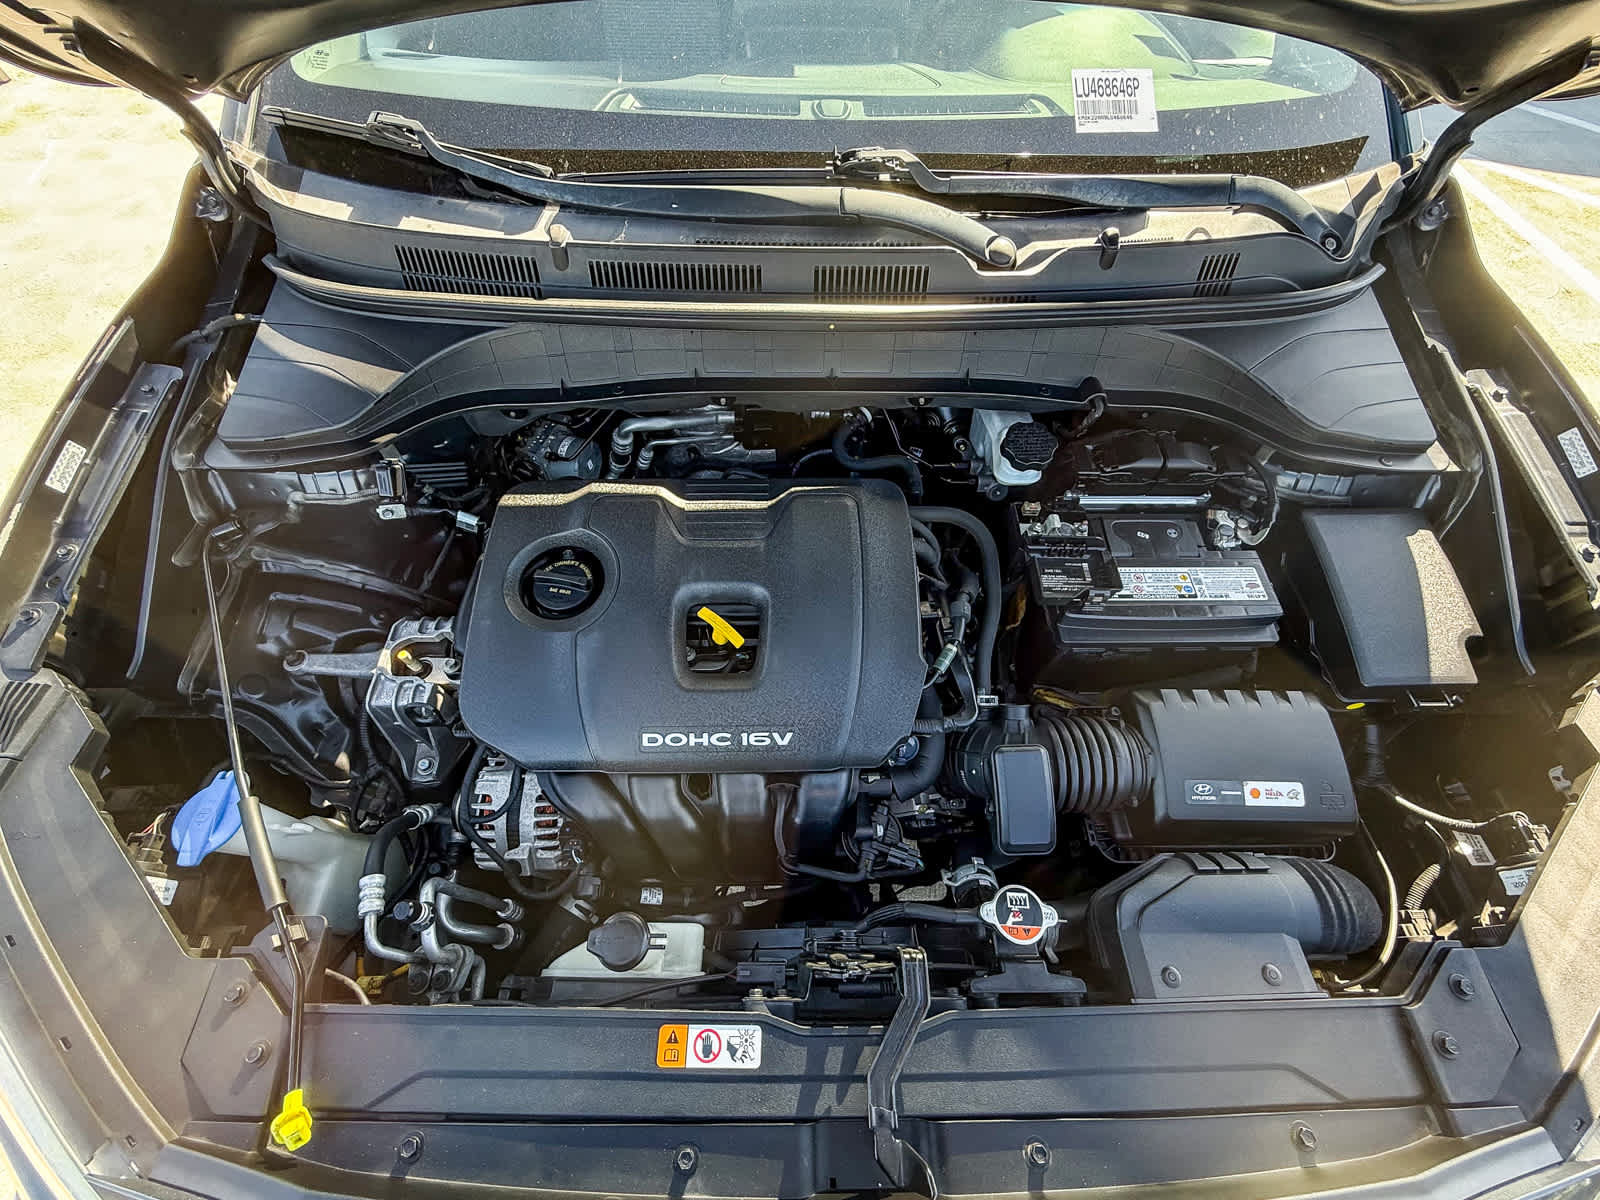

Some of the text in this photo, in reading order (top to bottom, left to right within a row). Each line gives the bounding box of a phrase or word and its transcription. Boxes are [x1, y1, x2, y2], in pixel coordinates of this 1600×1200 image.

[1075, 77, 1140, 98] LU468646P
[641, 732, 794, 747] DOHC 16V
